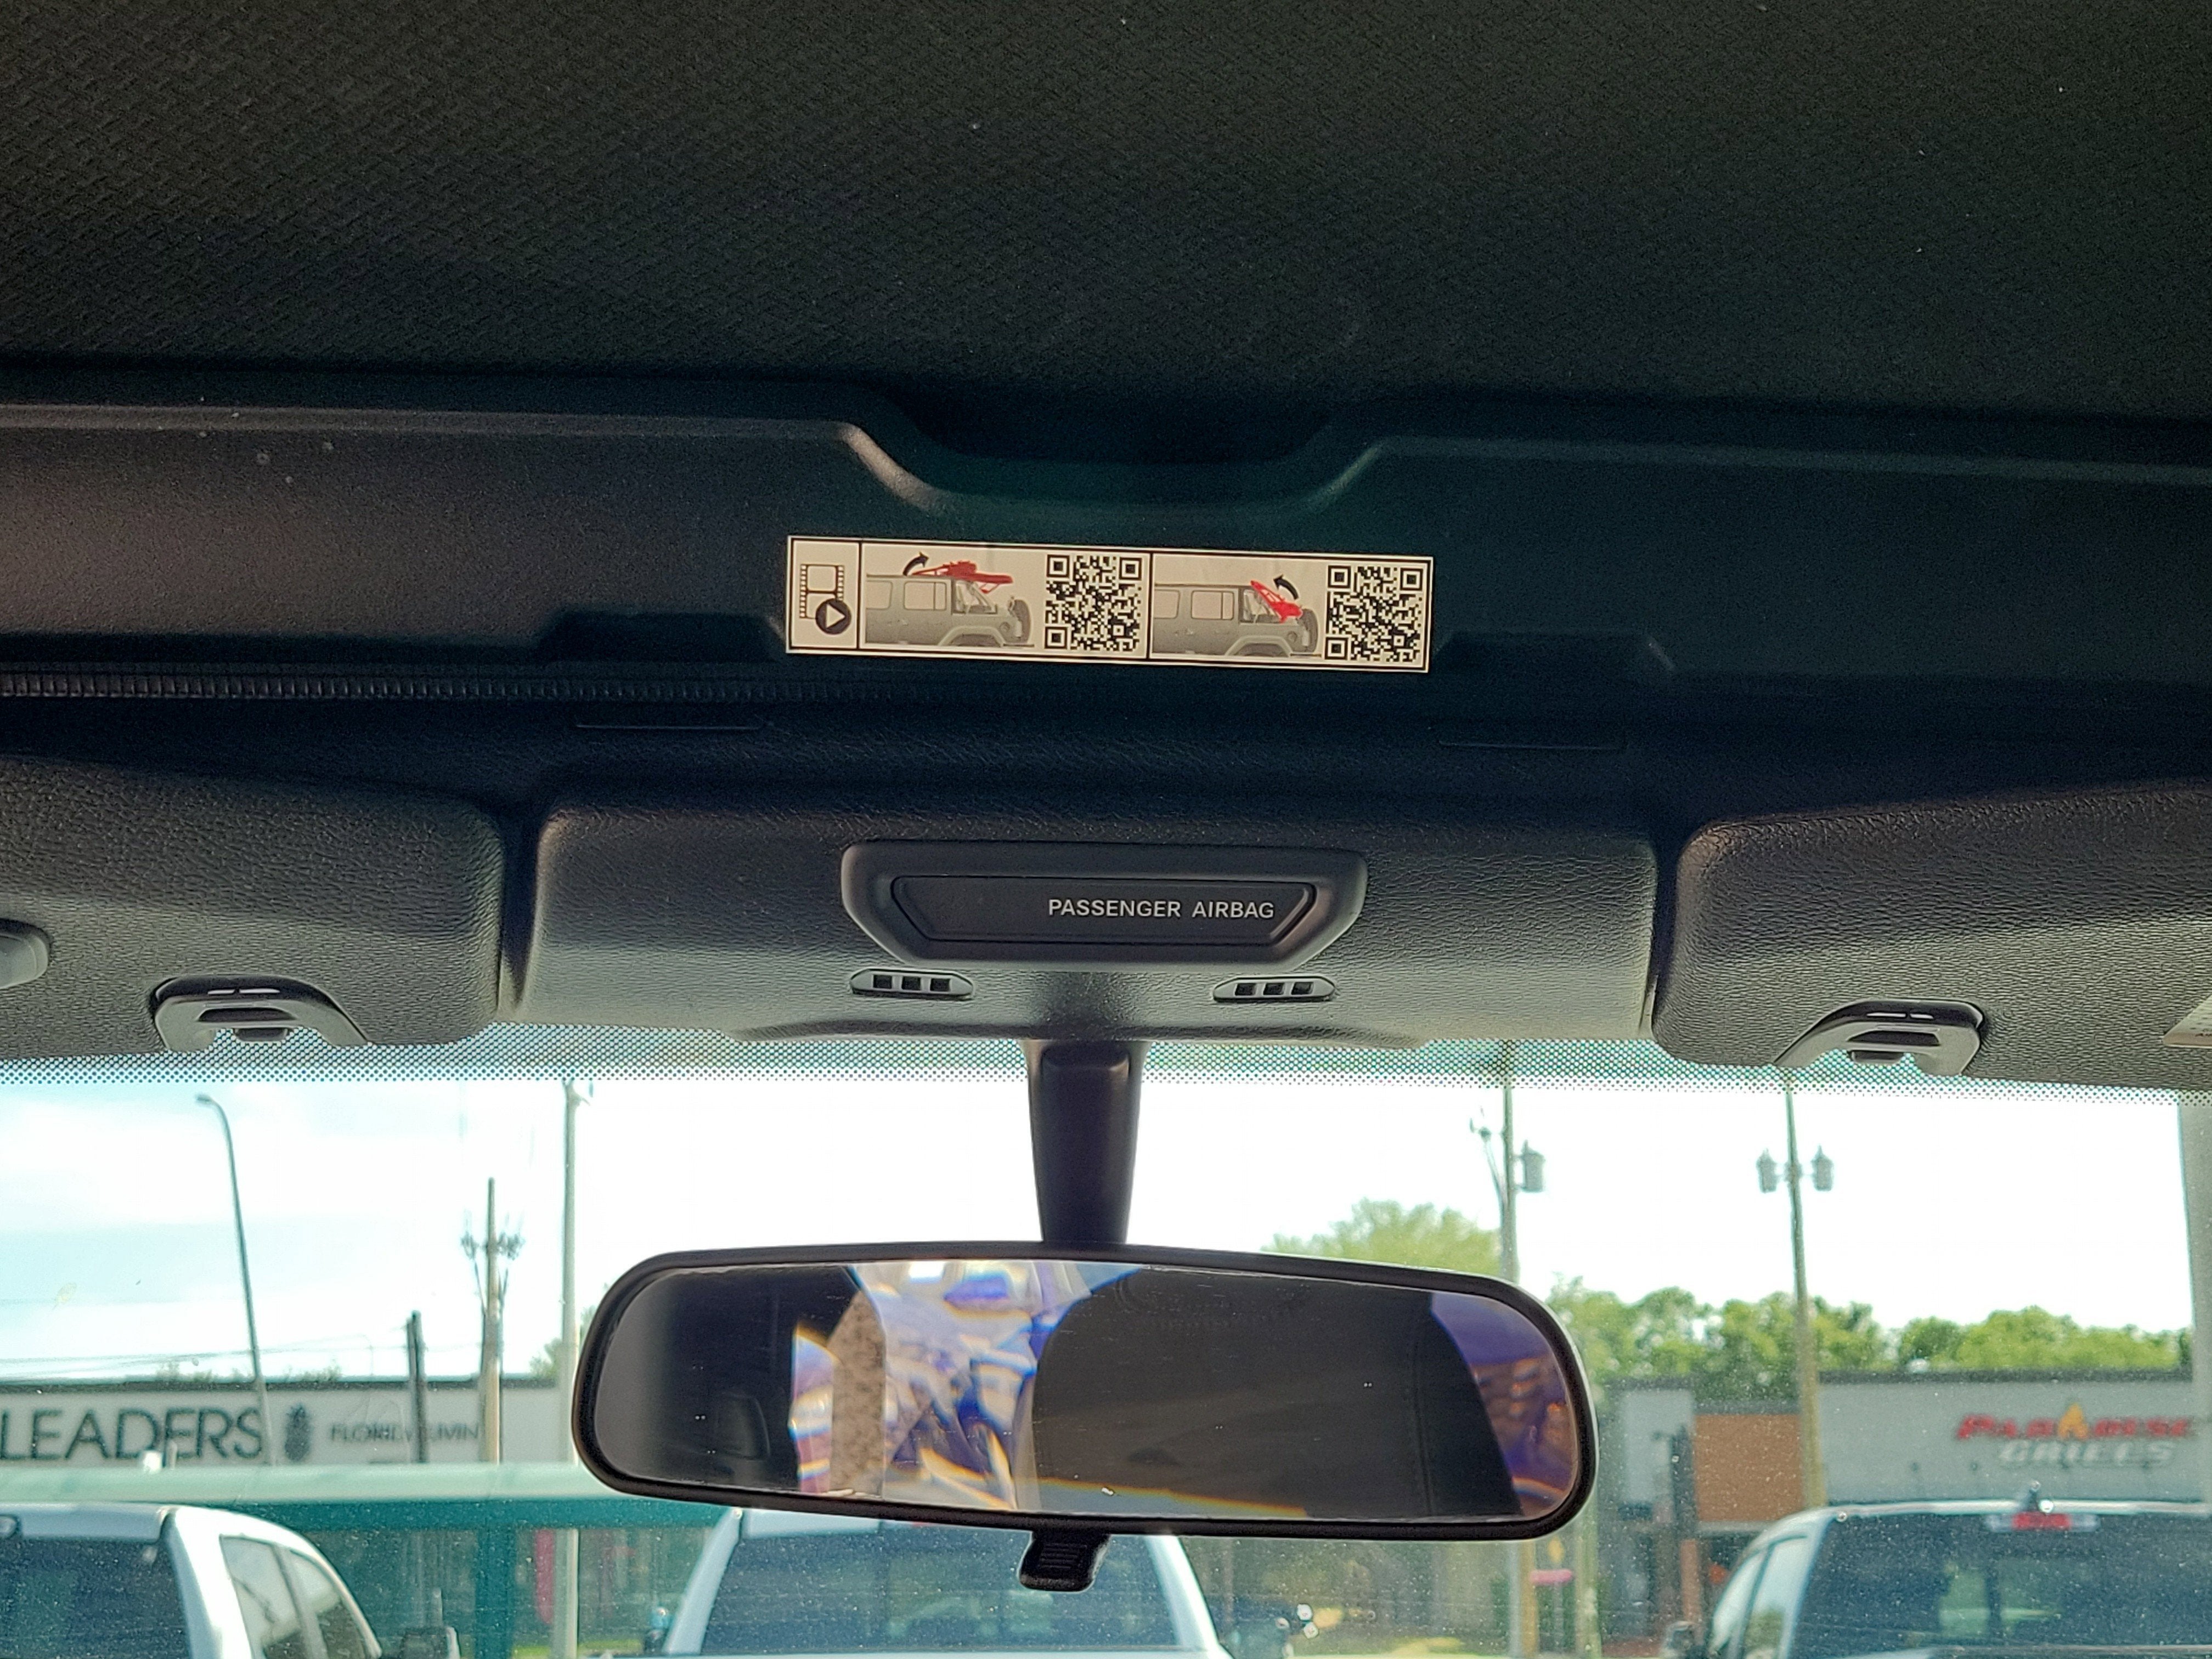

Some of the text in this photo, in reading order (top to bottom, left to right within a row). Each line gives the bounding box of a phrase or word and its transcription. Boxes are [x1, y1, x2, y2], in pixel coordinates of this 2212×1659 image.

[1048, 899, 1274, 919] PASSENGER AIRBAG
[0, 1407, 262, 1460] LEADERS
